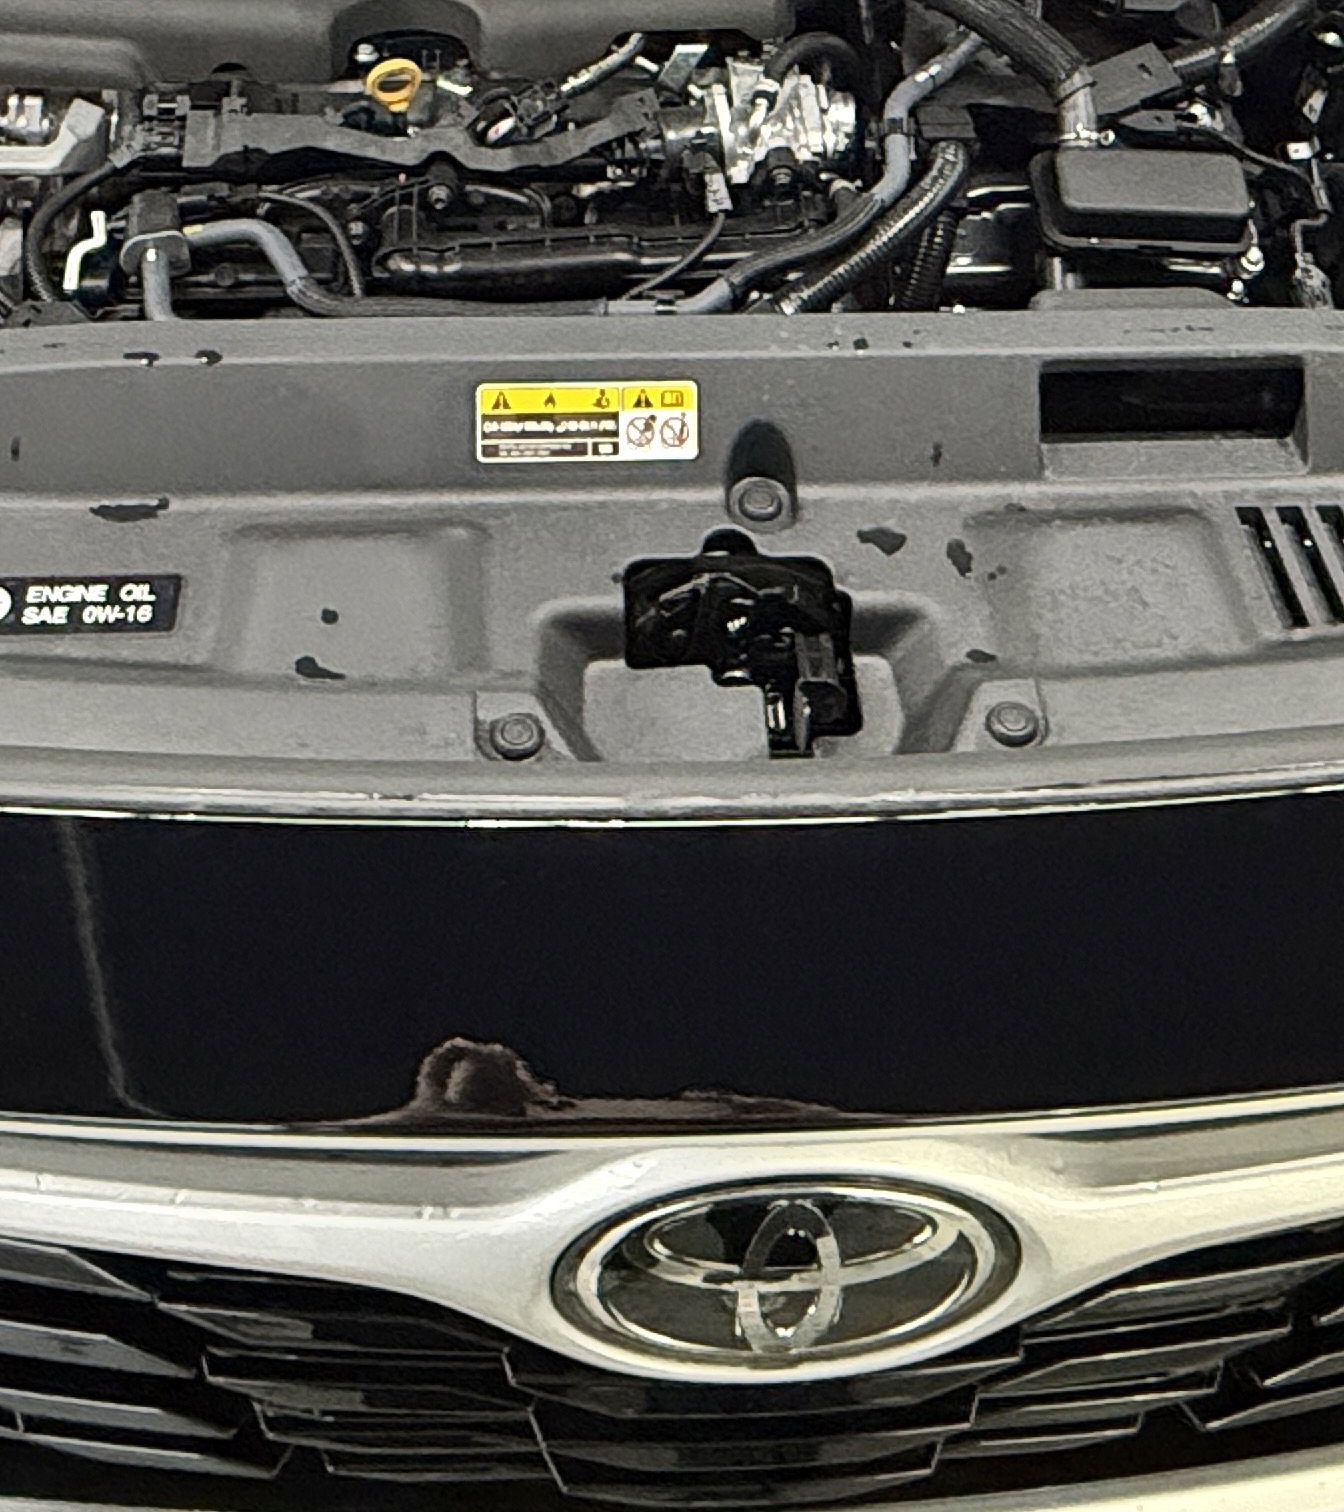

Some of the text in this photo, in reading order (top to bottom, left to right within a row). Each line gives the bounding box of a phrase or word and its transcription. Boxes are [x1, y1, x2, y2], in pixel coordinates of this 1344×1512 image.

[25, 582, 157, 603] ENGINE OIL
[21, 605, 70, 625] SAE
